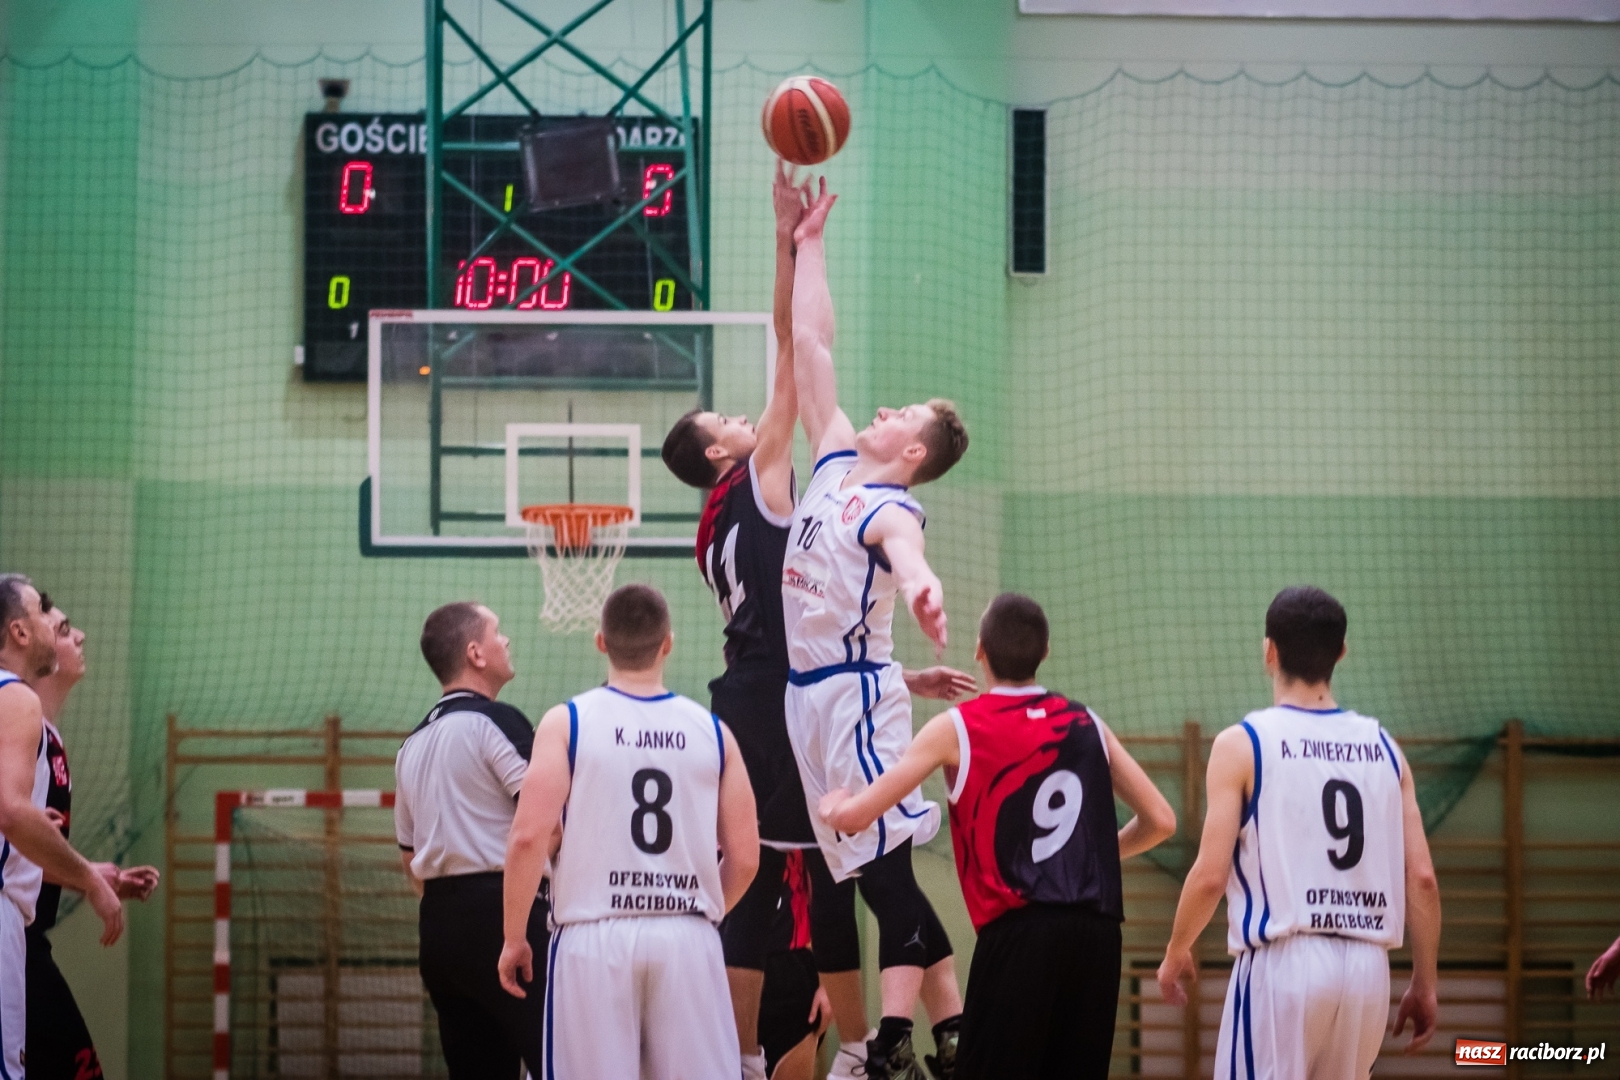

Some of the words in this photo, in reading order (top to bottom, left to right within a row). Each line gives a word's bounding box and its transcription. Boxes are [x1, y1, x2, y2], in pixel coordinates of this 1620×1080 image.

[340, 161, 373, 214] 0
[504, 183, 514, 213] 1
[328, 275, 350, 310] 0
[455, 256, 571, 310] 10:00
[653, 279, 676, 311] 0
[797, 515, 823, 551] 10
[615, 727, 631, 746] K.
[635, 730, 686, 751] JANKO
[1281, 739, 1297, 759] A.
[1300, 739, 1385, 763] ZWIERZYNA
[631, 768, 673, 855] 8
[1032, 769, 1083, 864] 9
[1322, 778, 1364, 871] 9
[609, 871, 700, 889] OFENSYWA
[611, 892, 699, 912] RACIBÓRZ
[1306, 888, 1388, 908] OFENSYWA
